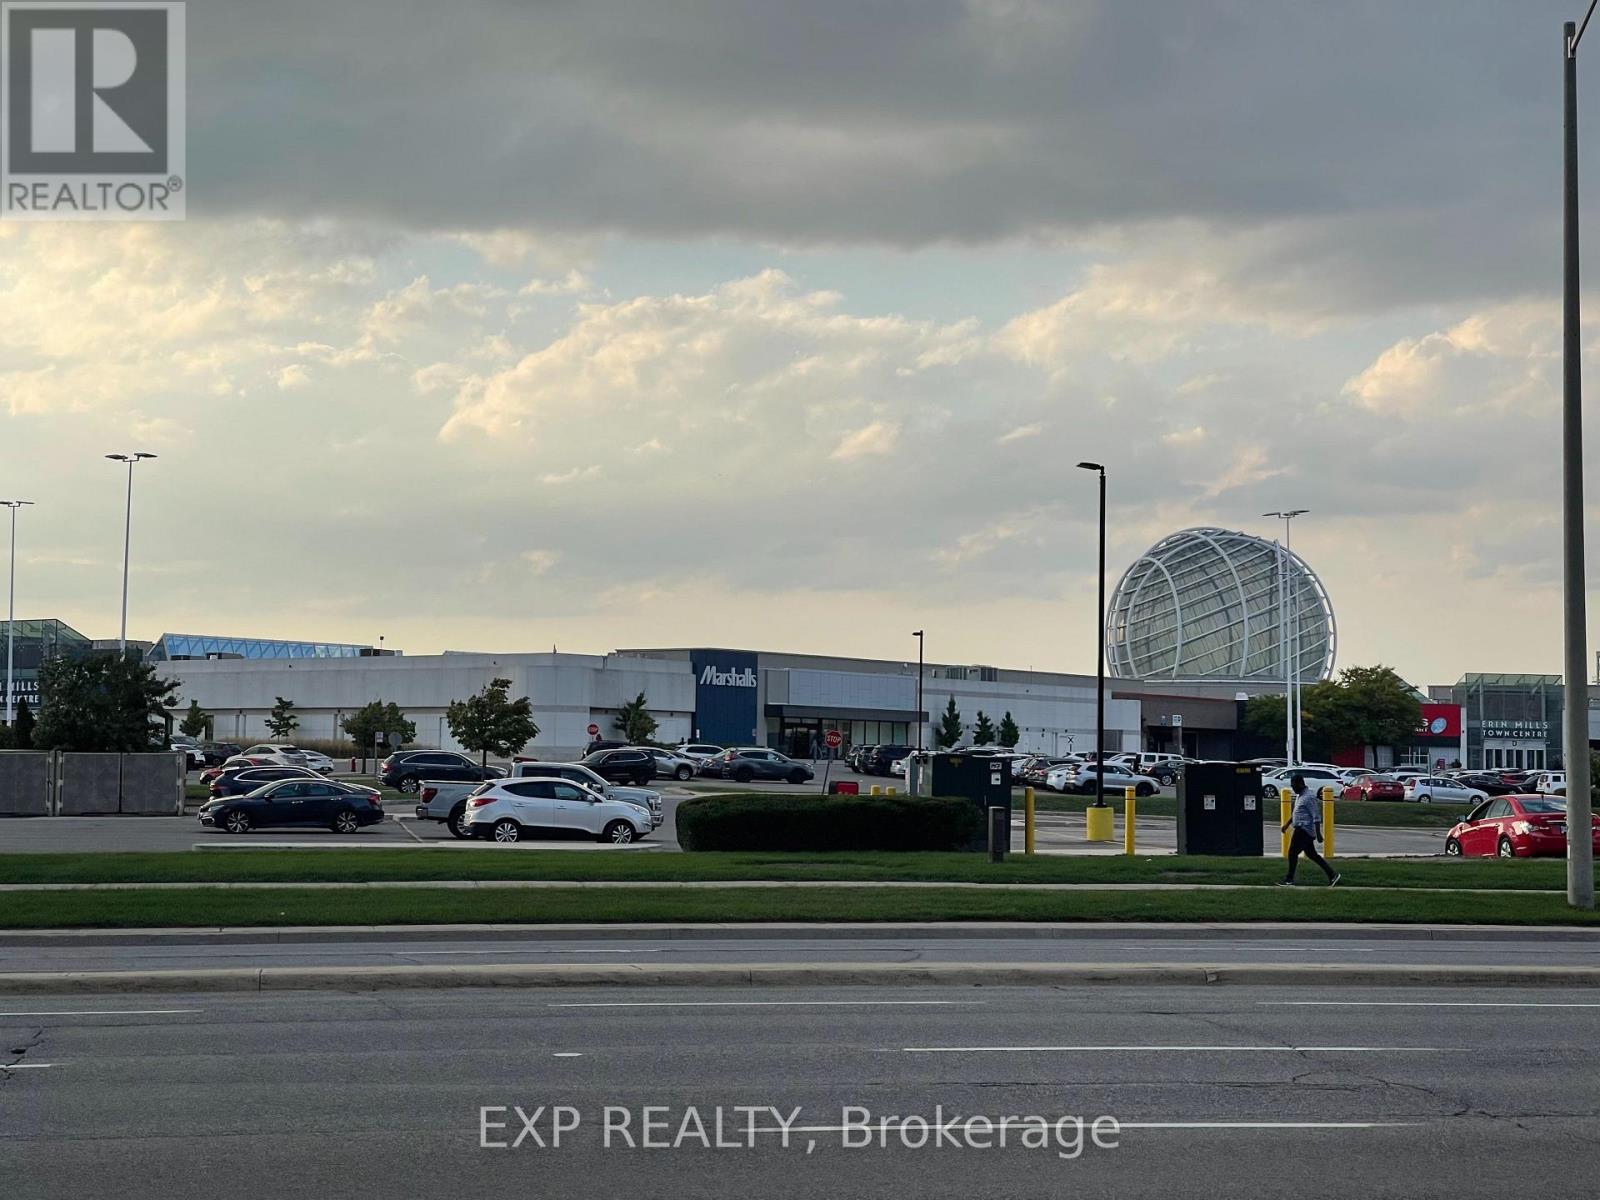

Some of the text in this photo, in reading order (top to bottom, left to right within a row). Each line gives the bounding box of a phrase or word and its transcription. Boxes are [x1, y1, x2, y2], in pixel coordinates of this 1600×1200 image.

[700, 665, 757, 688] Marshalls
[1481, 720, 1548, 729] ERIN MILLS
[1483, 729, 1548, 738] TOWN CENTRE
[826, 735, 841, 743] STOP
